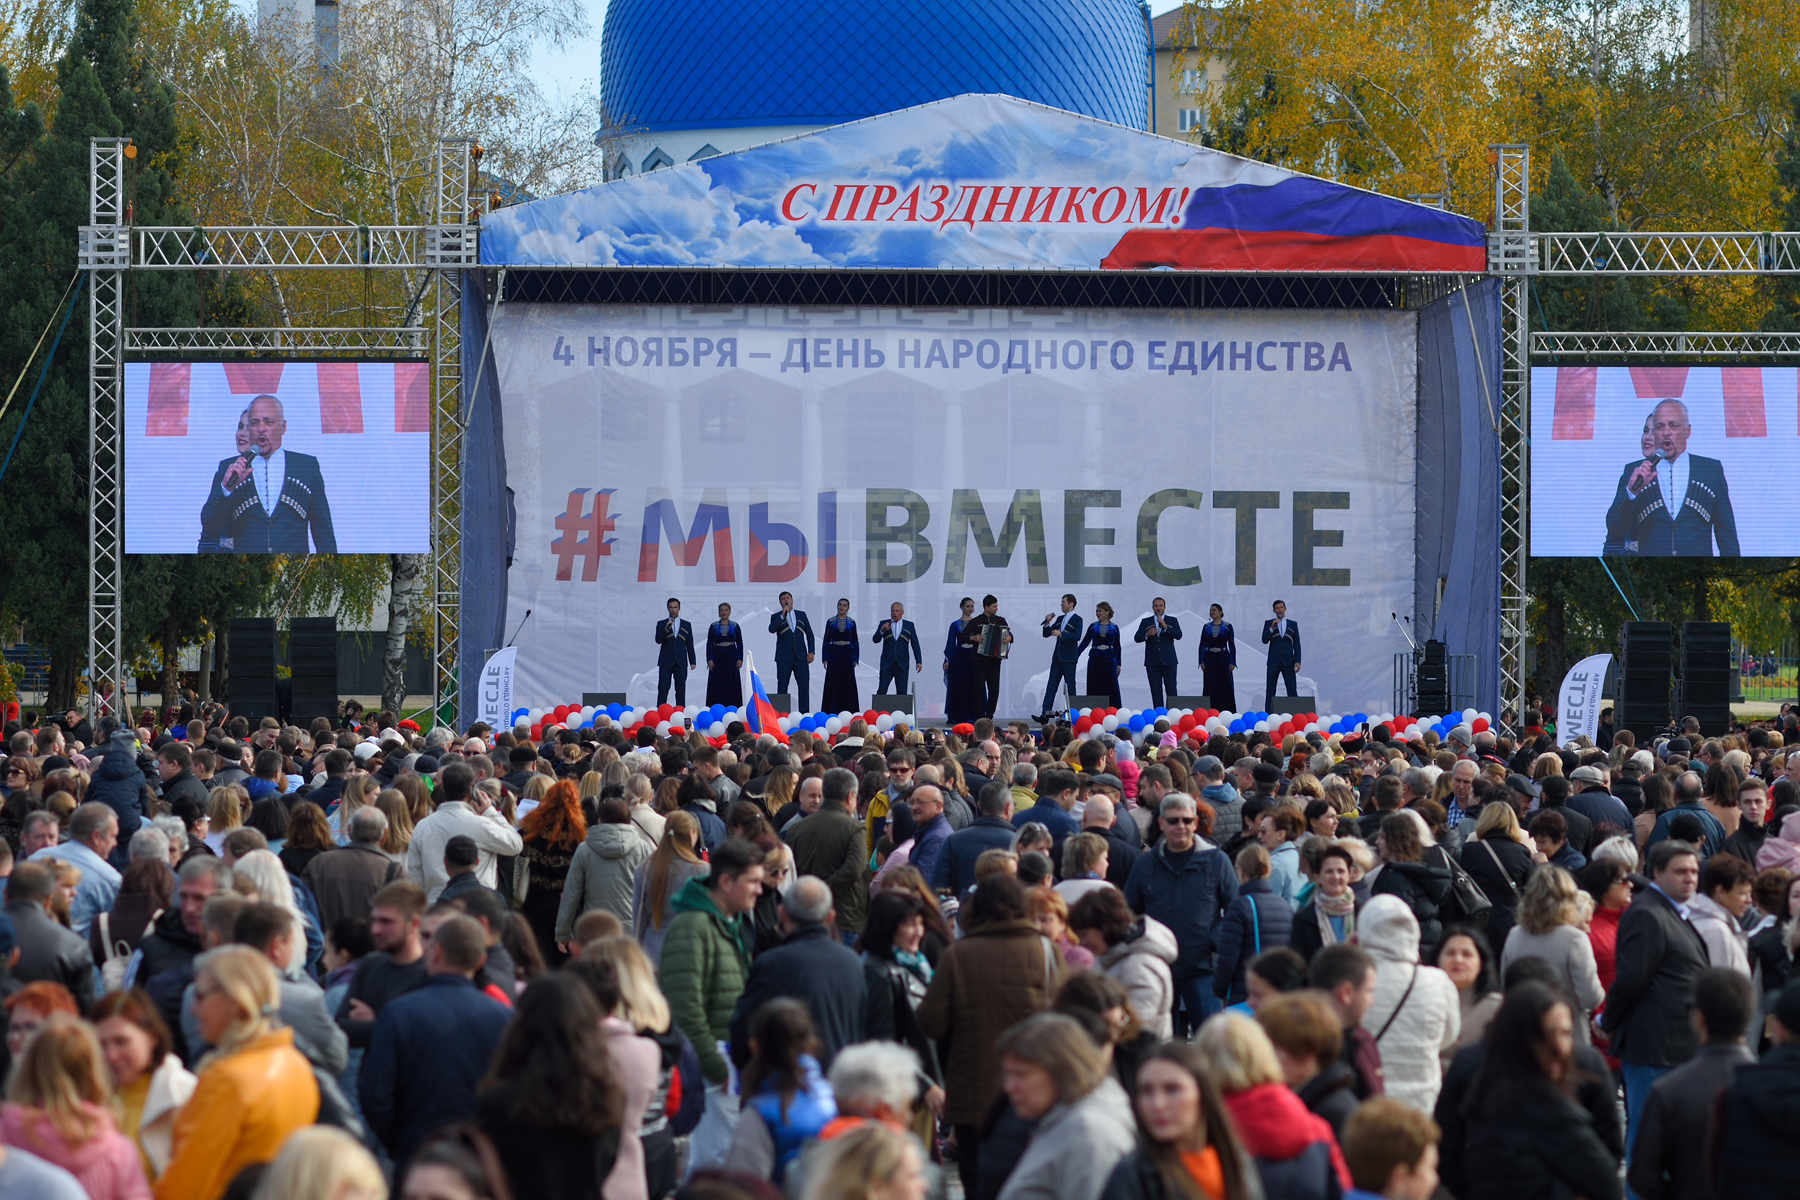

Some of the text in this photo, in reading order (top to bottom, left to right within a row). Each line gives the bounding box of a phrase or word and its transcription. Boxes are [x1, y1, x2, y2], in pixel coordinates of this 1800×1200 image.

[781, 183, 1191, 232] С ПРАЗДНИКОМ!
[552, 336, 575, 366] 4
[588, 336, 738, 367] НОЯБРЯ
[780, 338, 886, 373] ДЕНЬ
[898, 338, 1135, 375] НАРОДНОГО
[1147, 340, 1353, 376] ЕДИНСТВА
